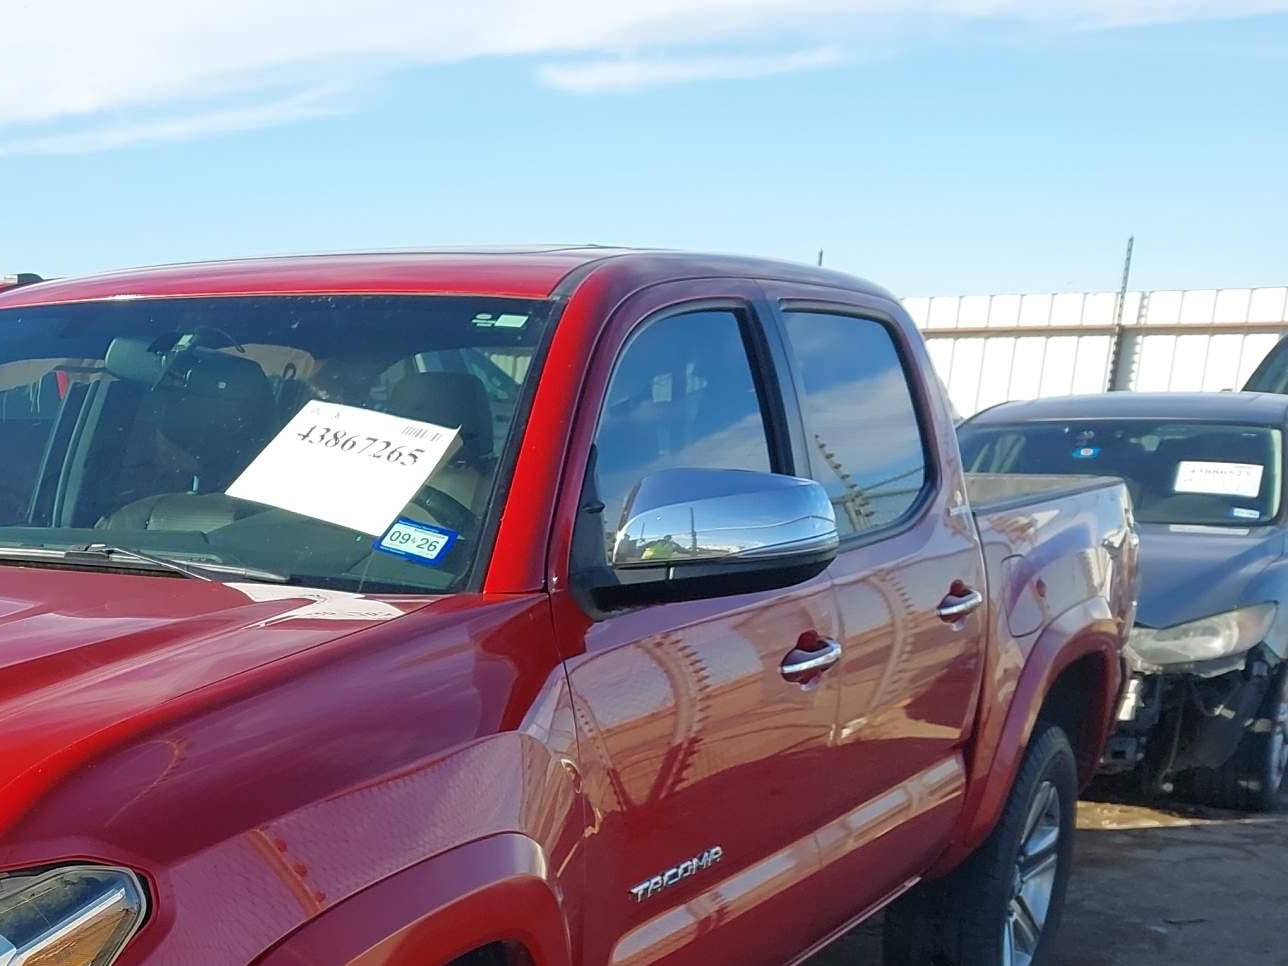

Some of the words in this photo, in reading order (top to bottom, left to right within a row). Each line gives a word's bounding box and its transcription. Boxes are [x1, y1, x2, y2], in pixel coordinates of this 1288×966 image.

[297, 424, 425, 466] 43867265
[389, 530, 411, 545] 09
[415, 537, 440, 552] 26
[630, 846, 723, 903] TACOMA
